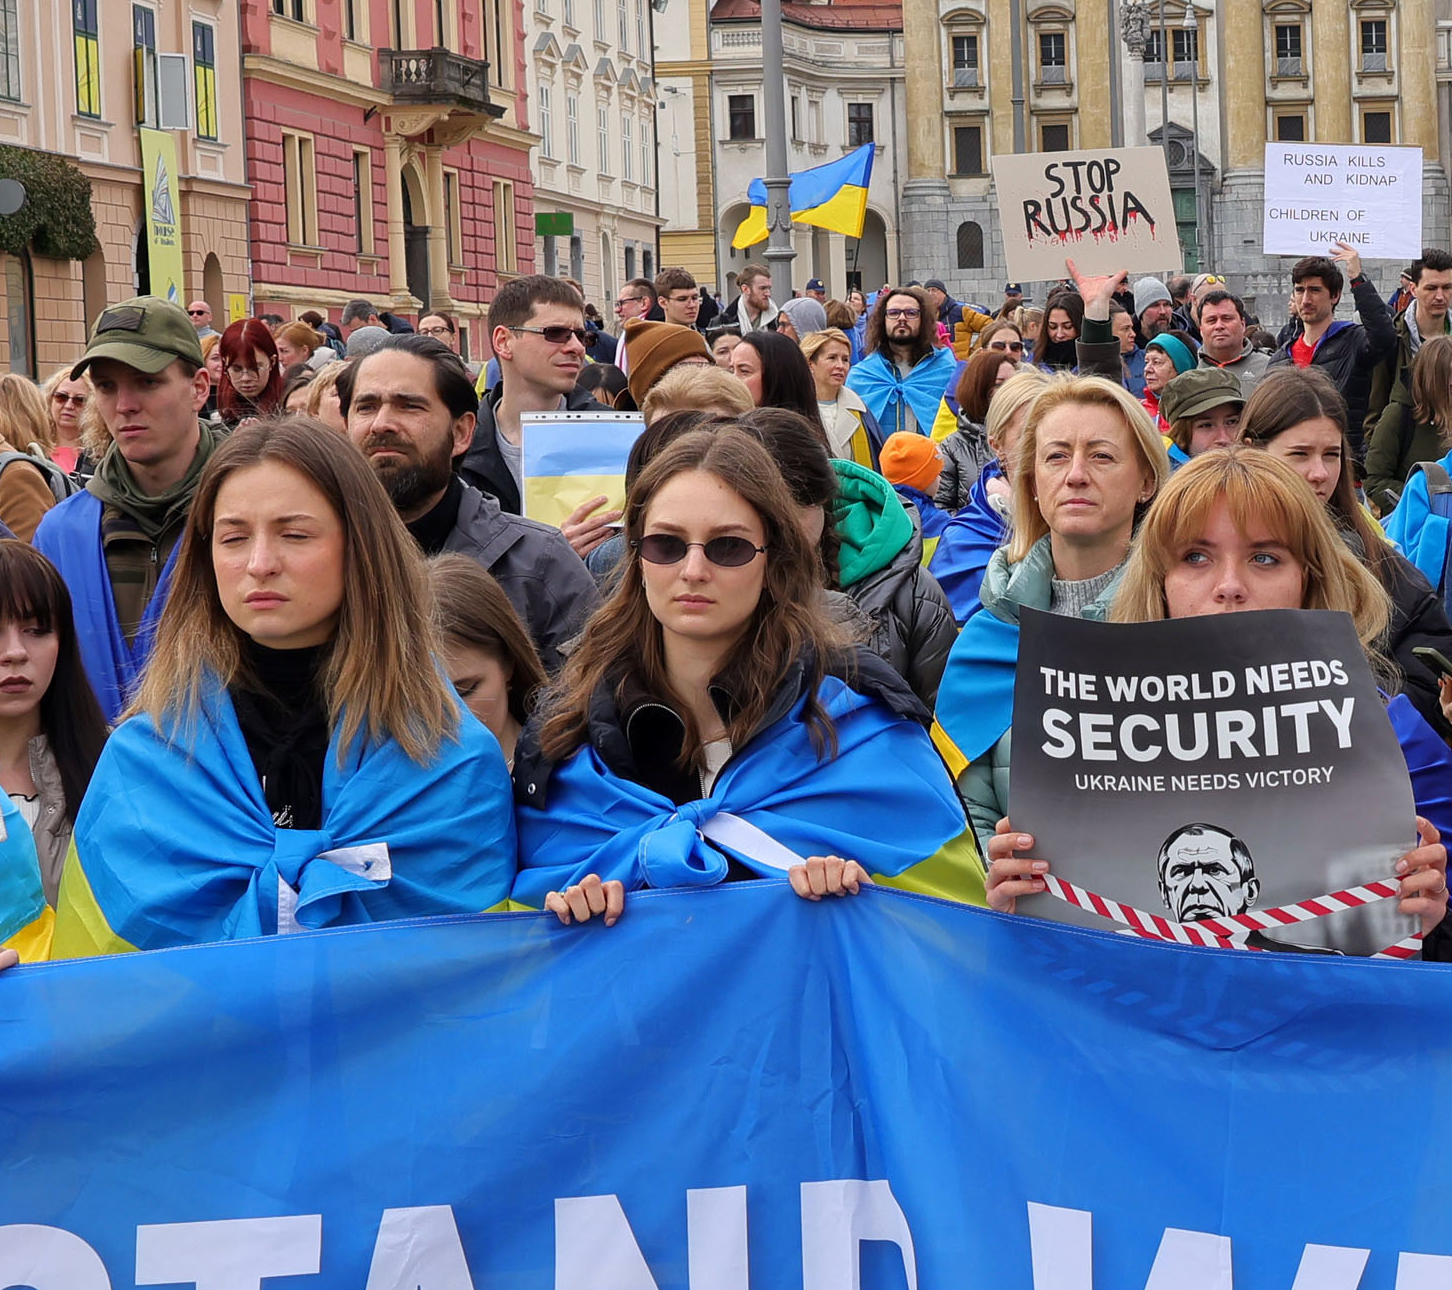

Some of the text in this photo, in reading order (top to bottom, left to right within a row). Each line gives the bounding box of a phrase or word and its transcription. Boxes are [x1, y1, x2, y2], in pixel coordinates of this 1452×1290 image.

[1283, 153, 1386, 168] RUSSIA KILLS
[1044, 158, 1121, 199] STOP
[1304, 173, 1397, 186] AND KIDNAP
[1022, 190, 1156, 240] RUSSIA
[1269, 208, 1367, 221] CHILDREN OF
[1309, 230, 1375, 244] UKRAINE.
[1040, 659, 1350, 703] THE WORLD NEEDS
[1041, 697, 1355, 762] SECURITY
[1075, 765, 1335, 792] UKRAINE NEEDS VICTORY
